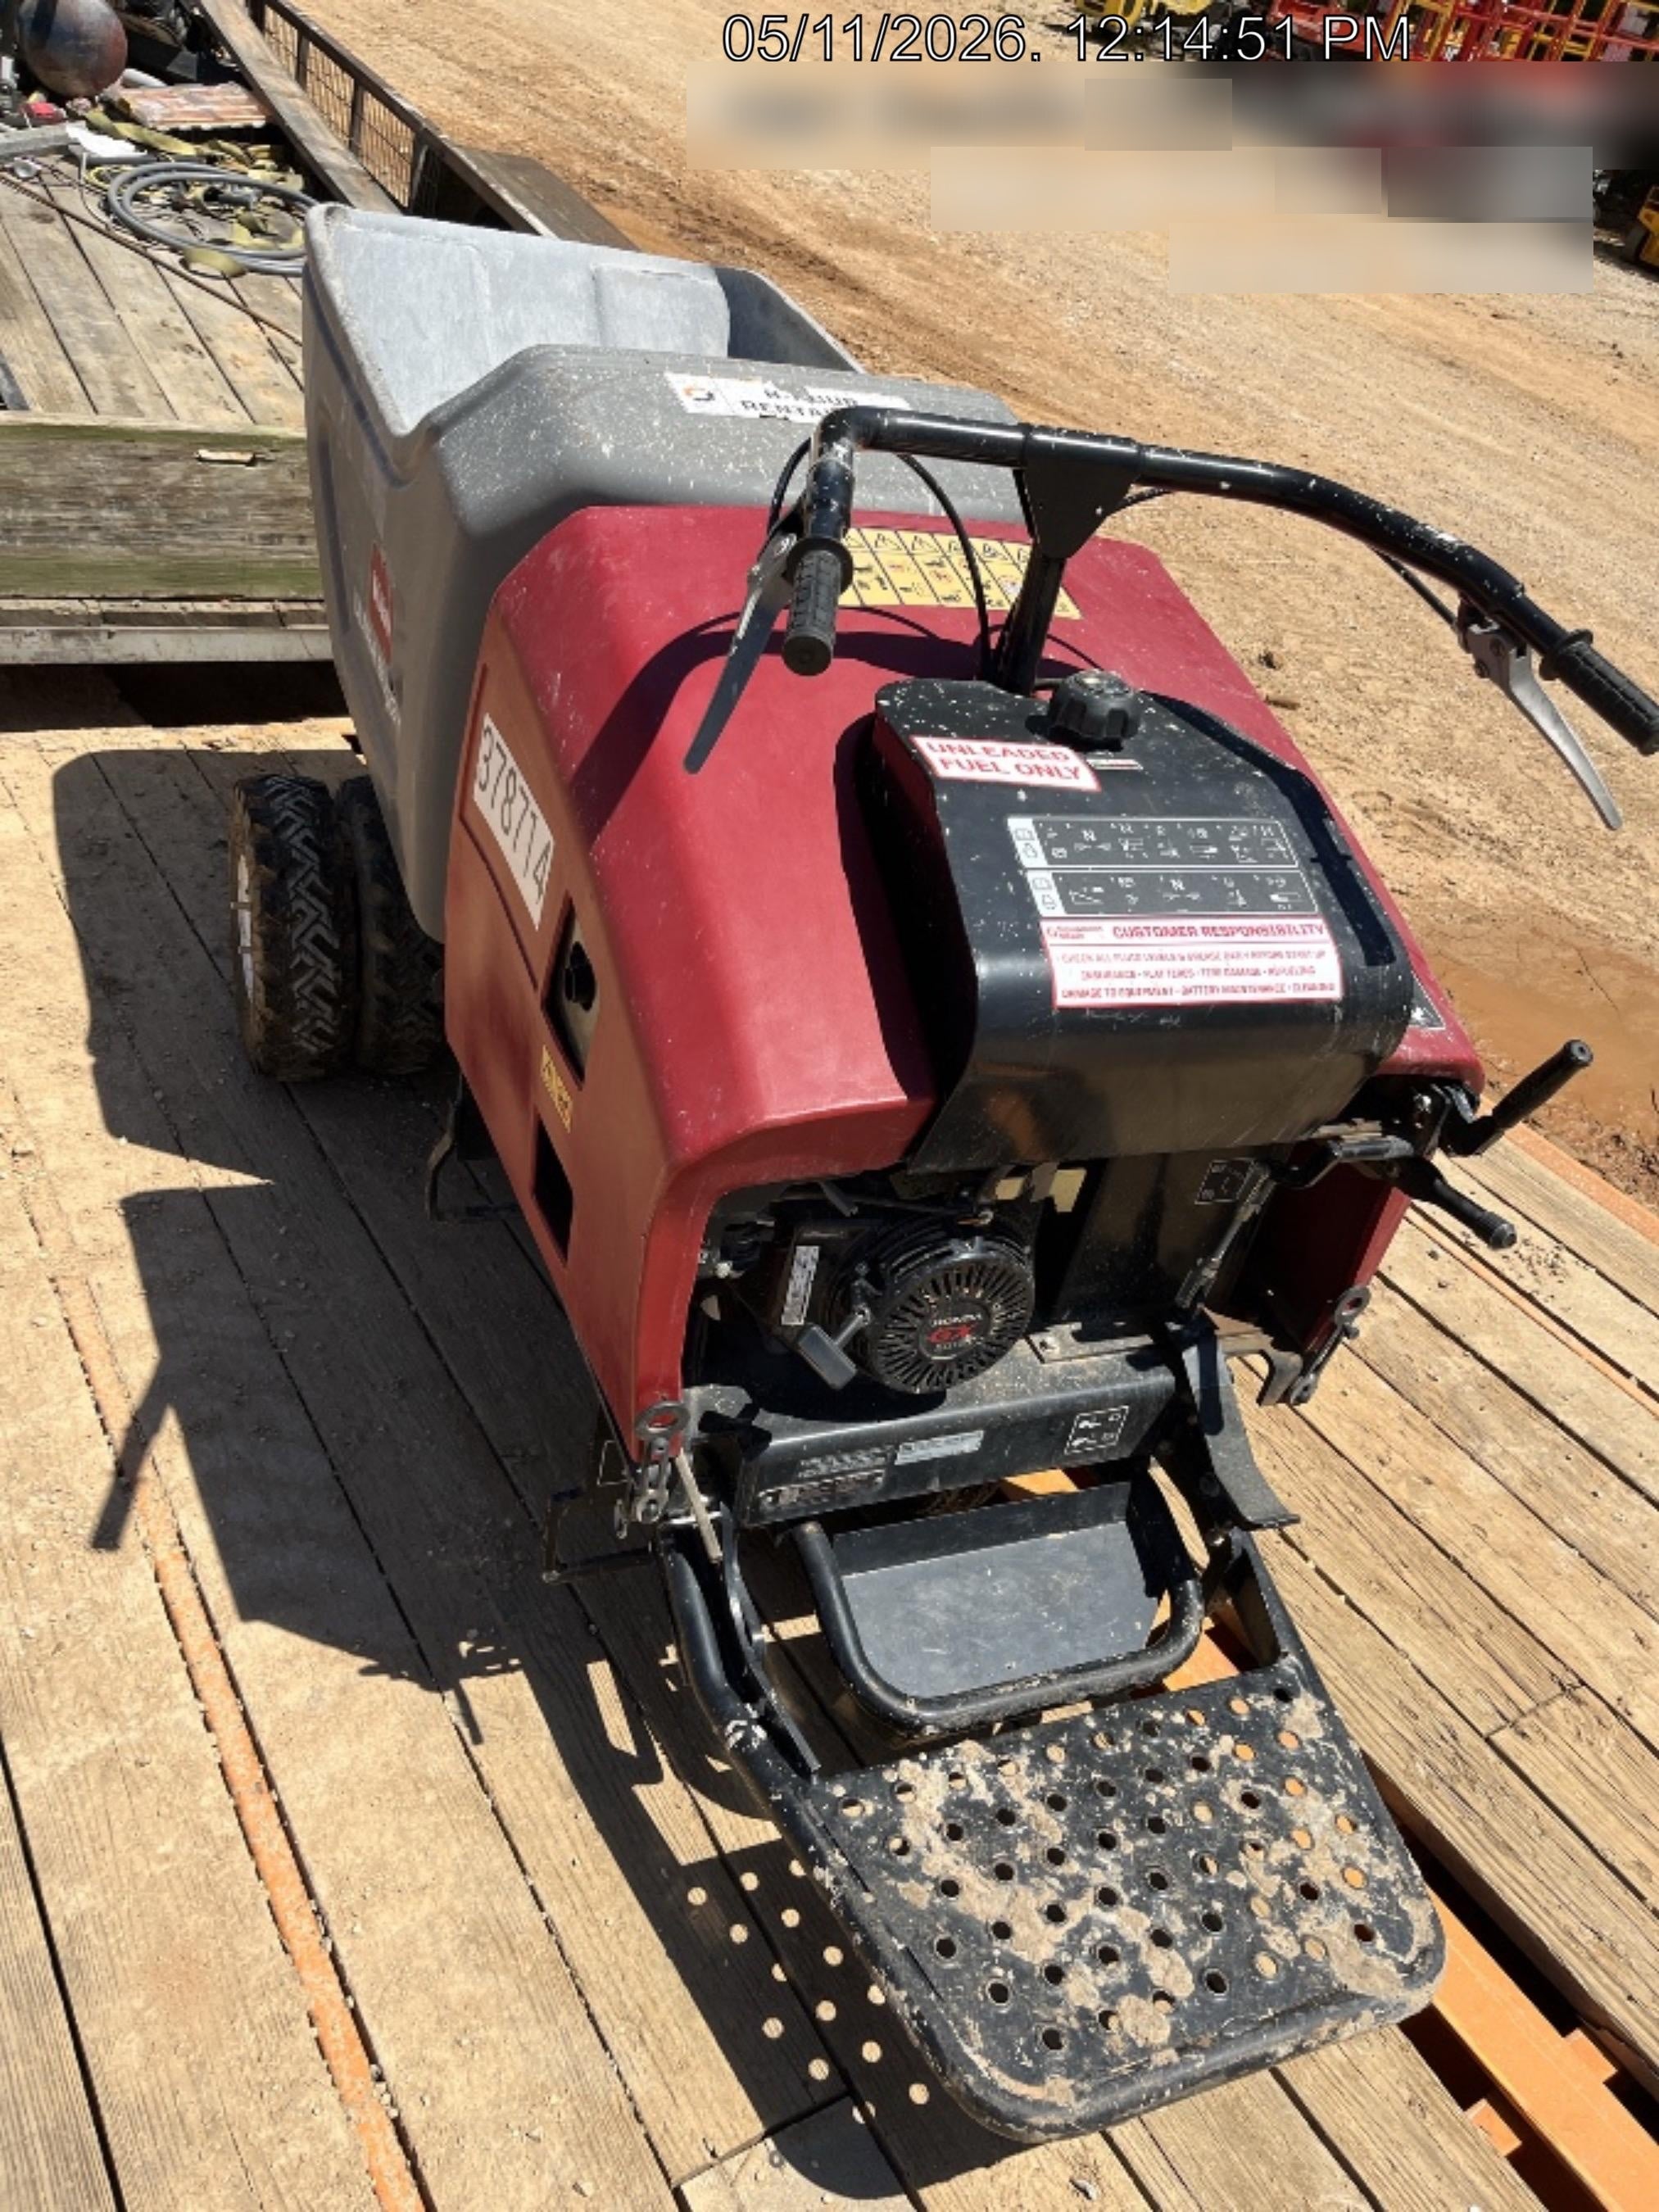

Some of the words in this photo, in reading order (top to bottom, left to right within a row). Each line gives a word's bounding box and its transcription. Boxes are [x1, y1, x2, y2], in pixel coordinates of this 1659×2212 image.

[926, 741, 1069, 761] UNLEADED
[939, 758, 1011, 775] FUEL
[1015, 763, 1081, 780] ONLY
[478, 724, 551, 905] 378714
[1113, 925, 1197, 938] CUSTOMER
[1201, 923, 1324, 937] RESPONSIBILITY
